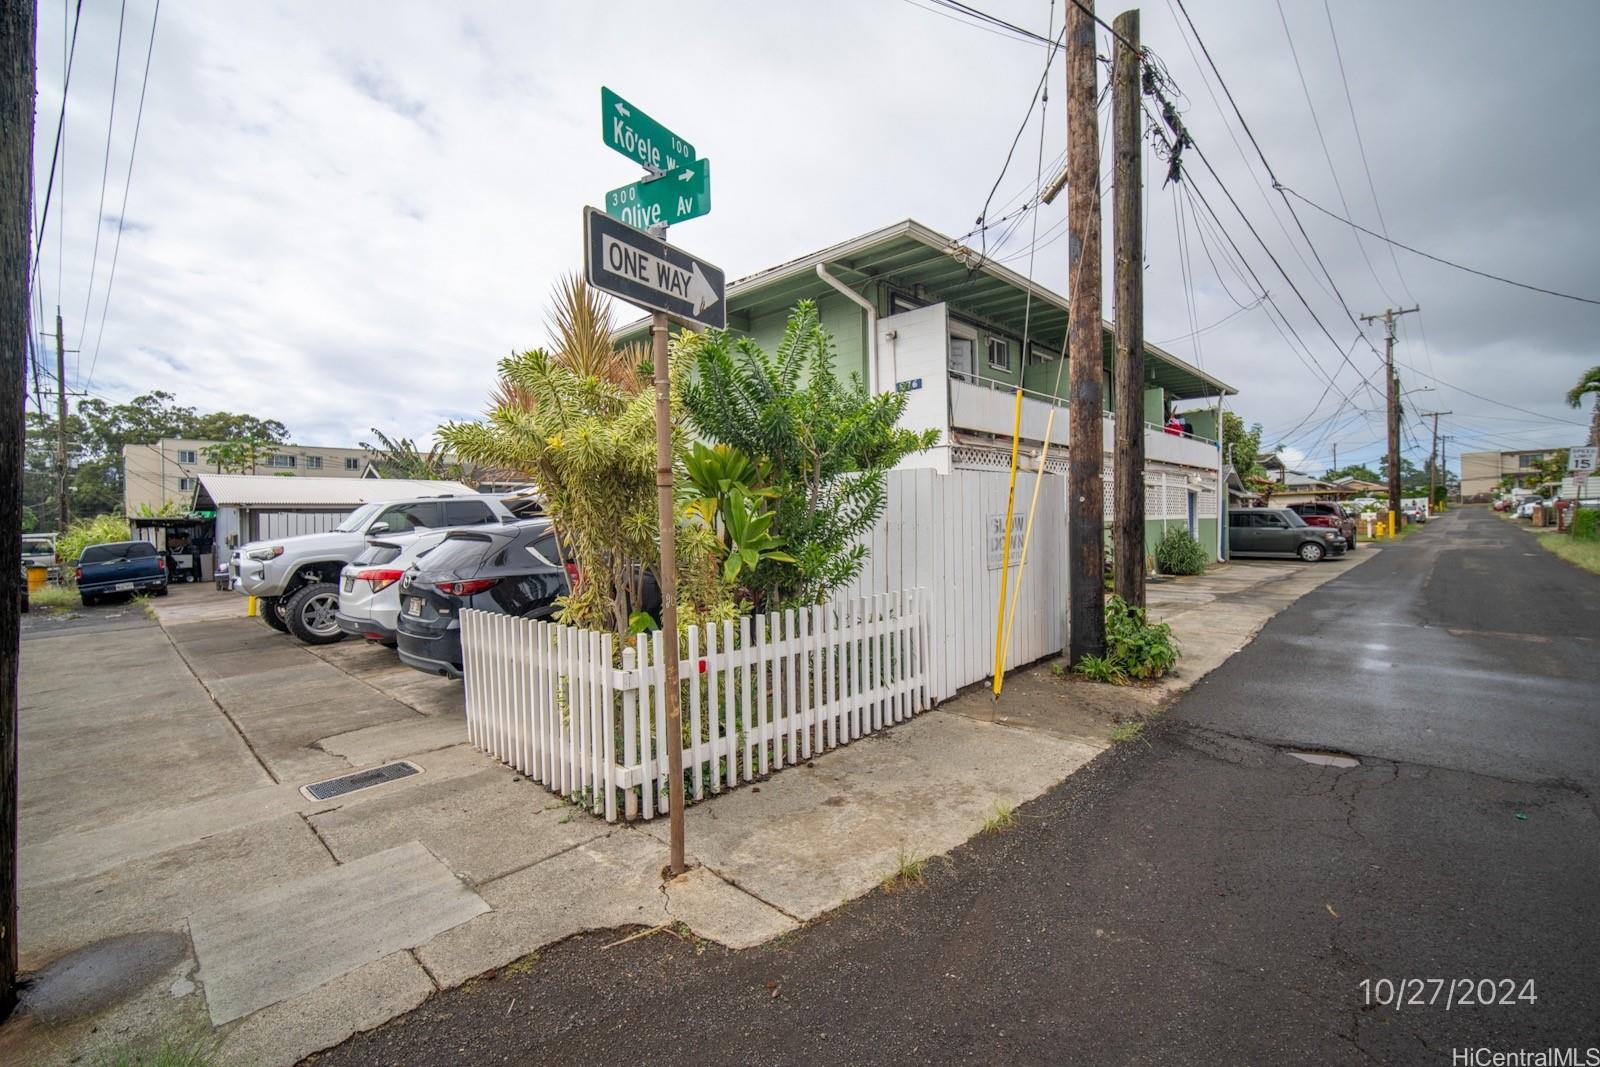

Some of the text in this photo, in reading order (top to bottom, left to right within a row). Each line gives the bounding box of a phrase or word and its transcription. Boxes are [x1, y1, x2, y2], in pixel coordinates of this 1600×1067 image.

[672, 137, 688, 158] 100
[612, 187, 636, 206] 300
[621, 195, 693, 228] Olive Av
[609, 242, 692, 298] ONE WAY
[1575, 459, 1591, 469] 15
